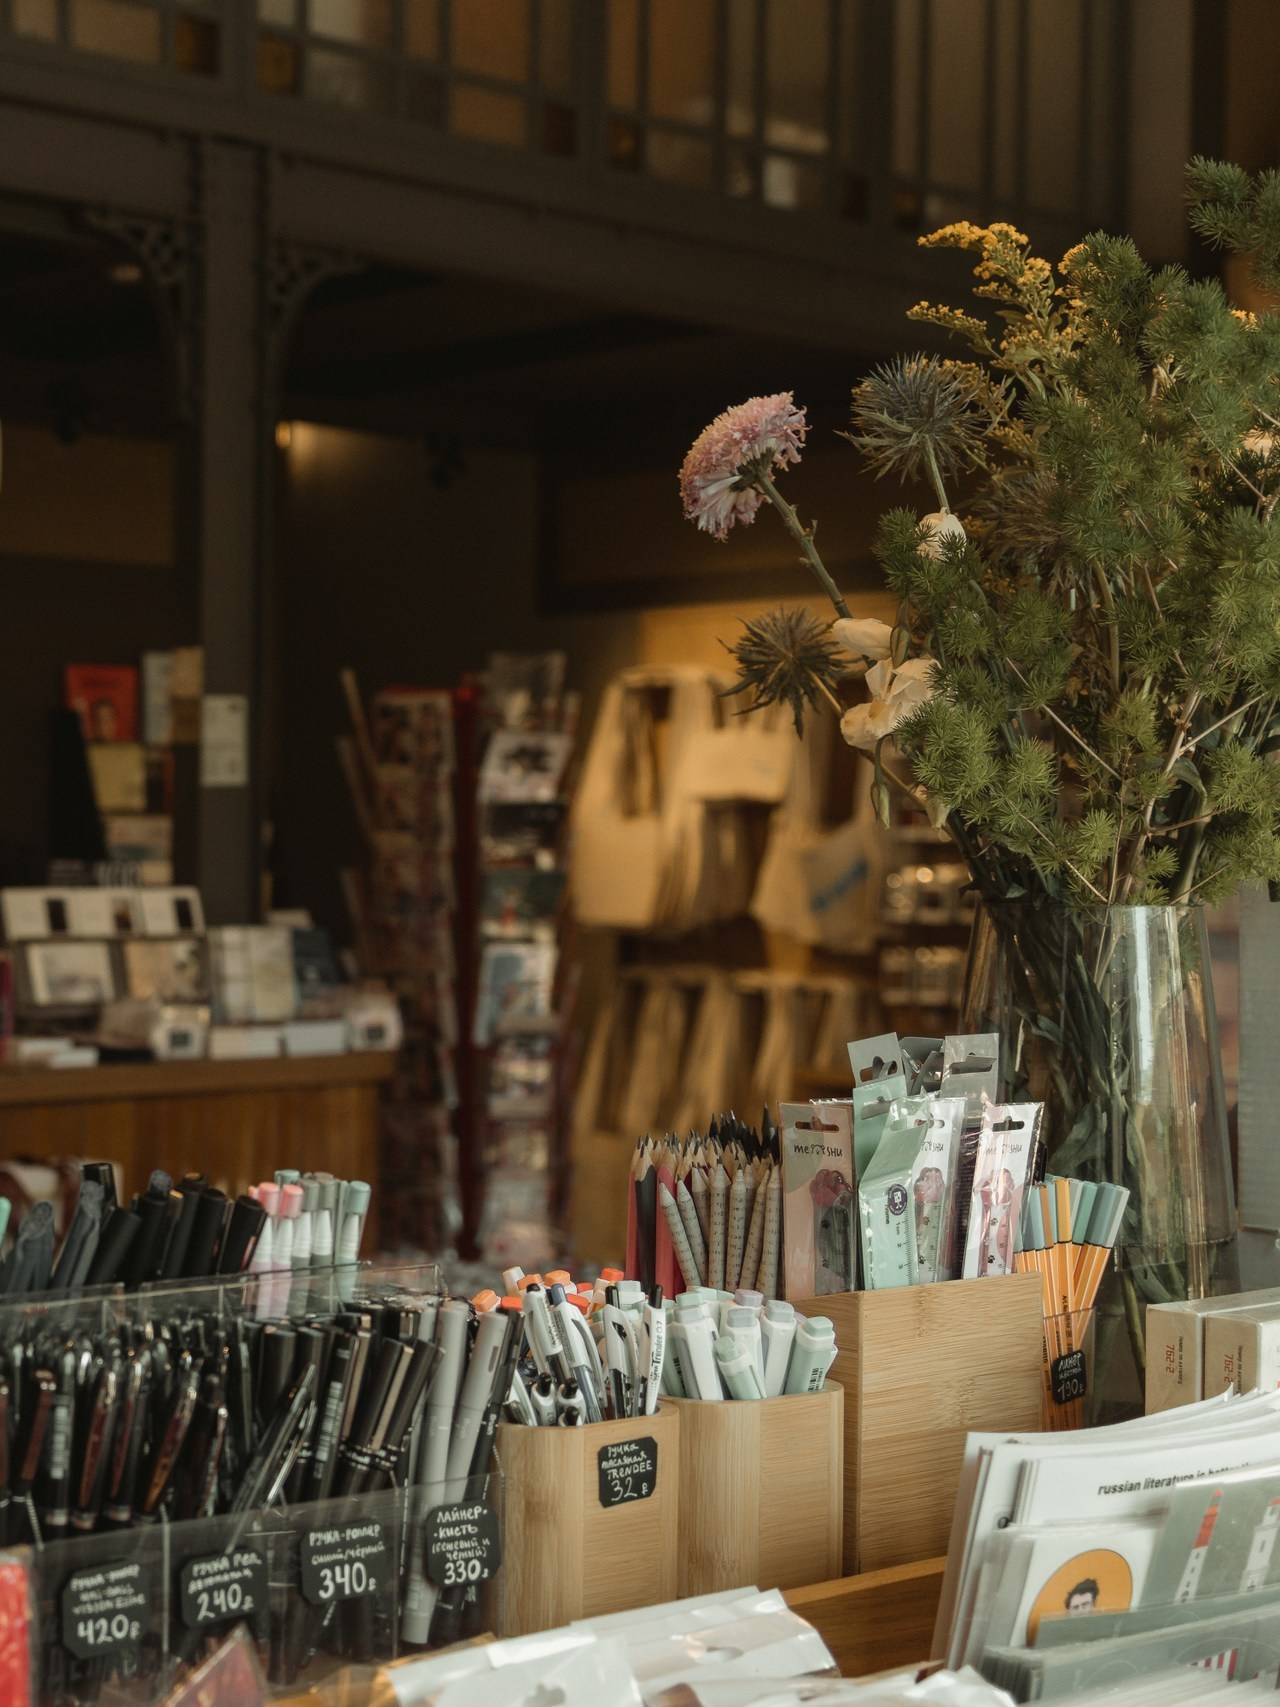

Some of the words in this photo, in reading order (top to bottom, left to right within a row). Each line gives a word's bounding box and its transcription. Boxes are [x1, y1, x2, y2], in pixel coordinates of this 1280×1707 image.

[1165, 1344, 1175, 1374] 762-2
[1223, 1354, 1234, 1384] 762-2
[1097, 1480, 1141, 1496] russian
